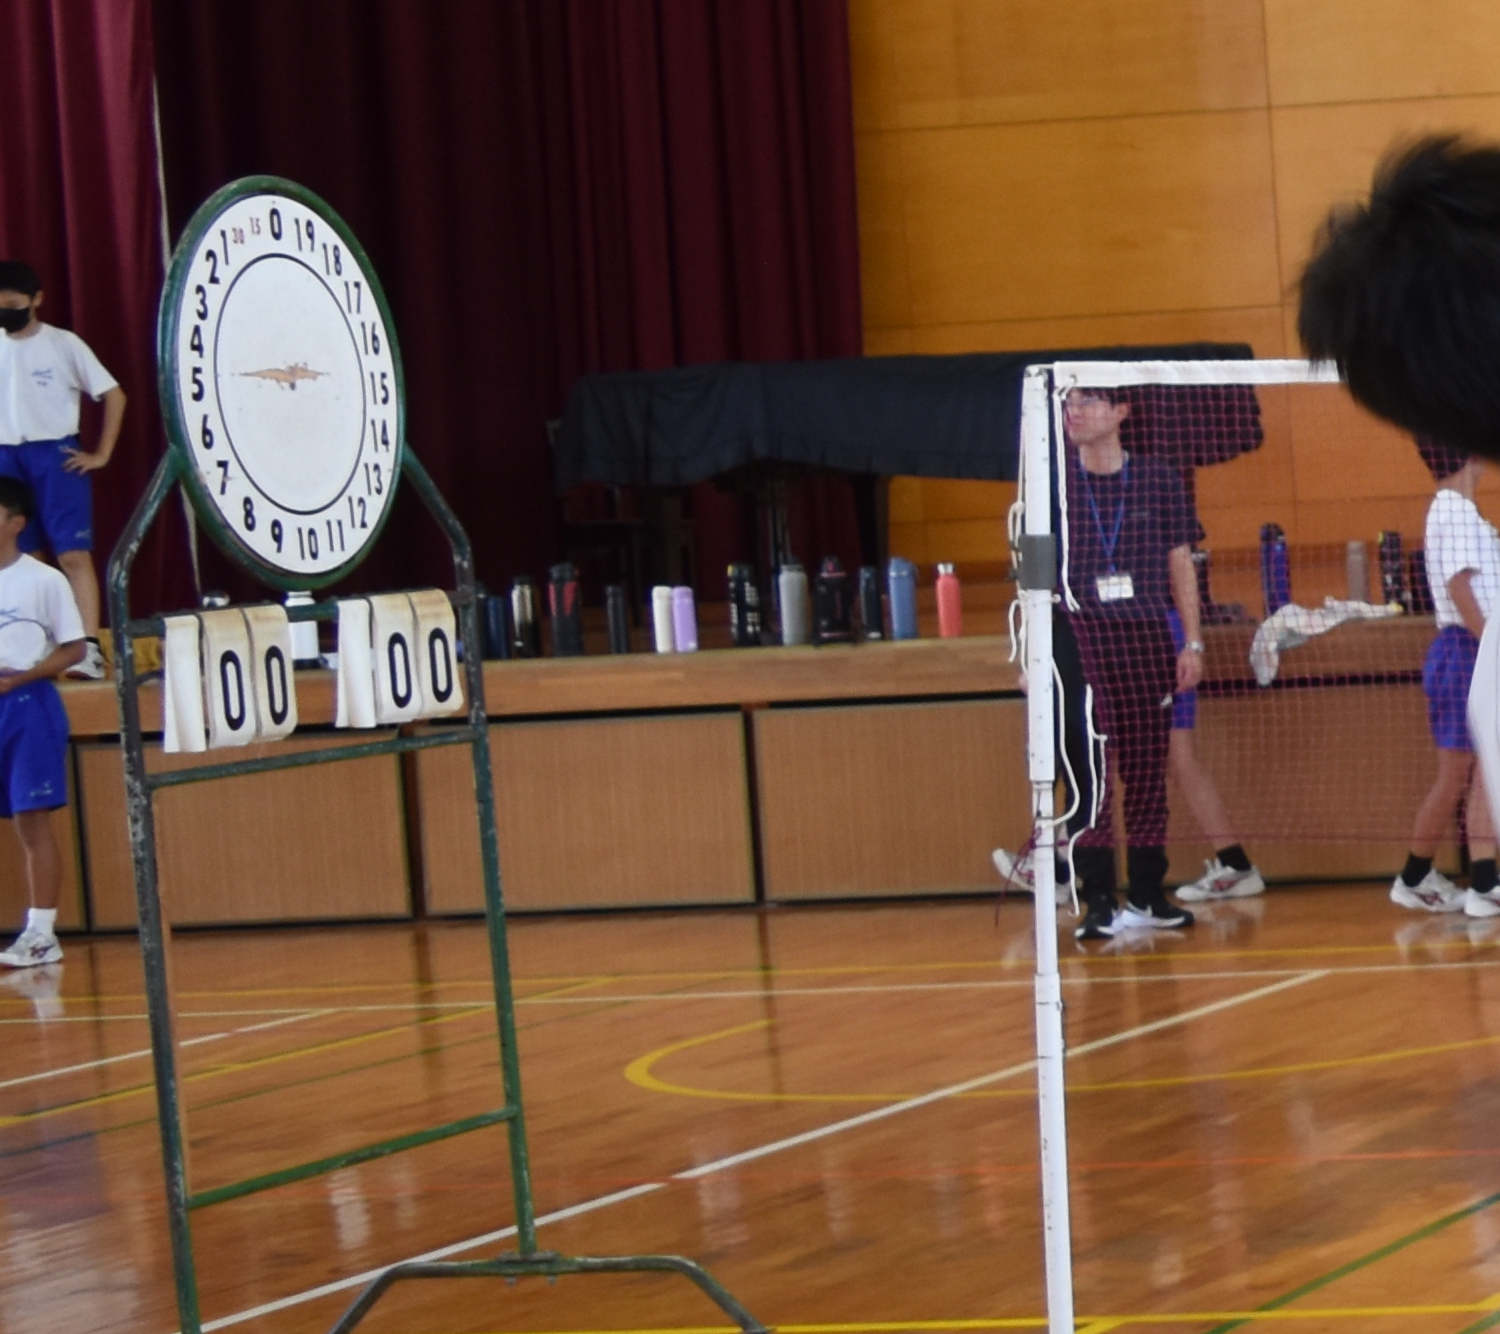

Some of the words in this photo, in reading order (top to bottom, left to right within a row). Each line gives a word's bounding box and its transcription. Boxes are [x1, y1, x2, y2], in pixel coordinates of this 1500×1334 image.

[268, 207, 282, 242] 0
[294, 218, 316, 252] 19
[219, 230, 230, 265] 1
[322, 243, 343, 277] 18
[206, 249, 221, 284] 2
[195, 285, 209, 321] 3
[343, 280, 363, 315] 17
[190, 324, 204, 358] 4
[360, 320, 381, 356] 16
[191, 367, 206, 402] 5
[369, 370, 390, 406] 15
[201, 414, 214, 450] 6
[370, 418, 391, 453] 14
[216, 460, 230, 496] 7
[363, 462, 384, 497] 13
[243, 497, 257, 532] 8
[348, 496, 369, 530] 12
[271, 519, 284, 553] 9
[297, 527, 319, 561] 10
[326, 519, 345, 552] 11
